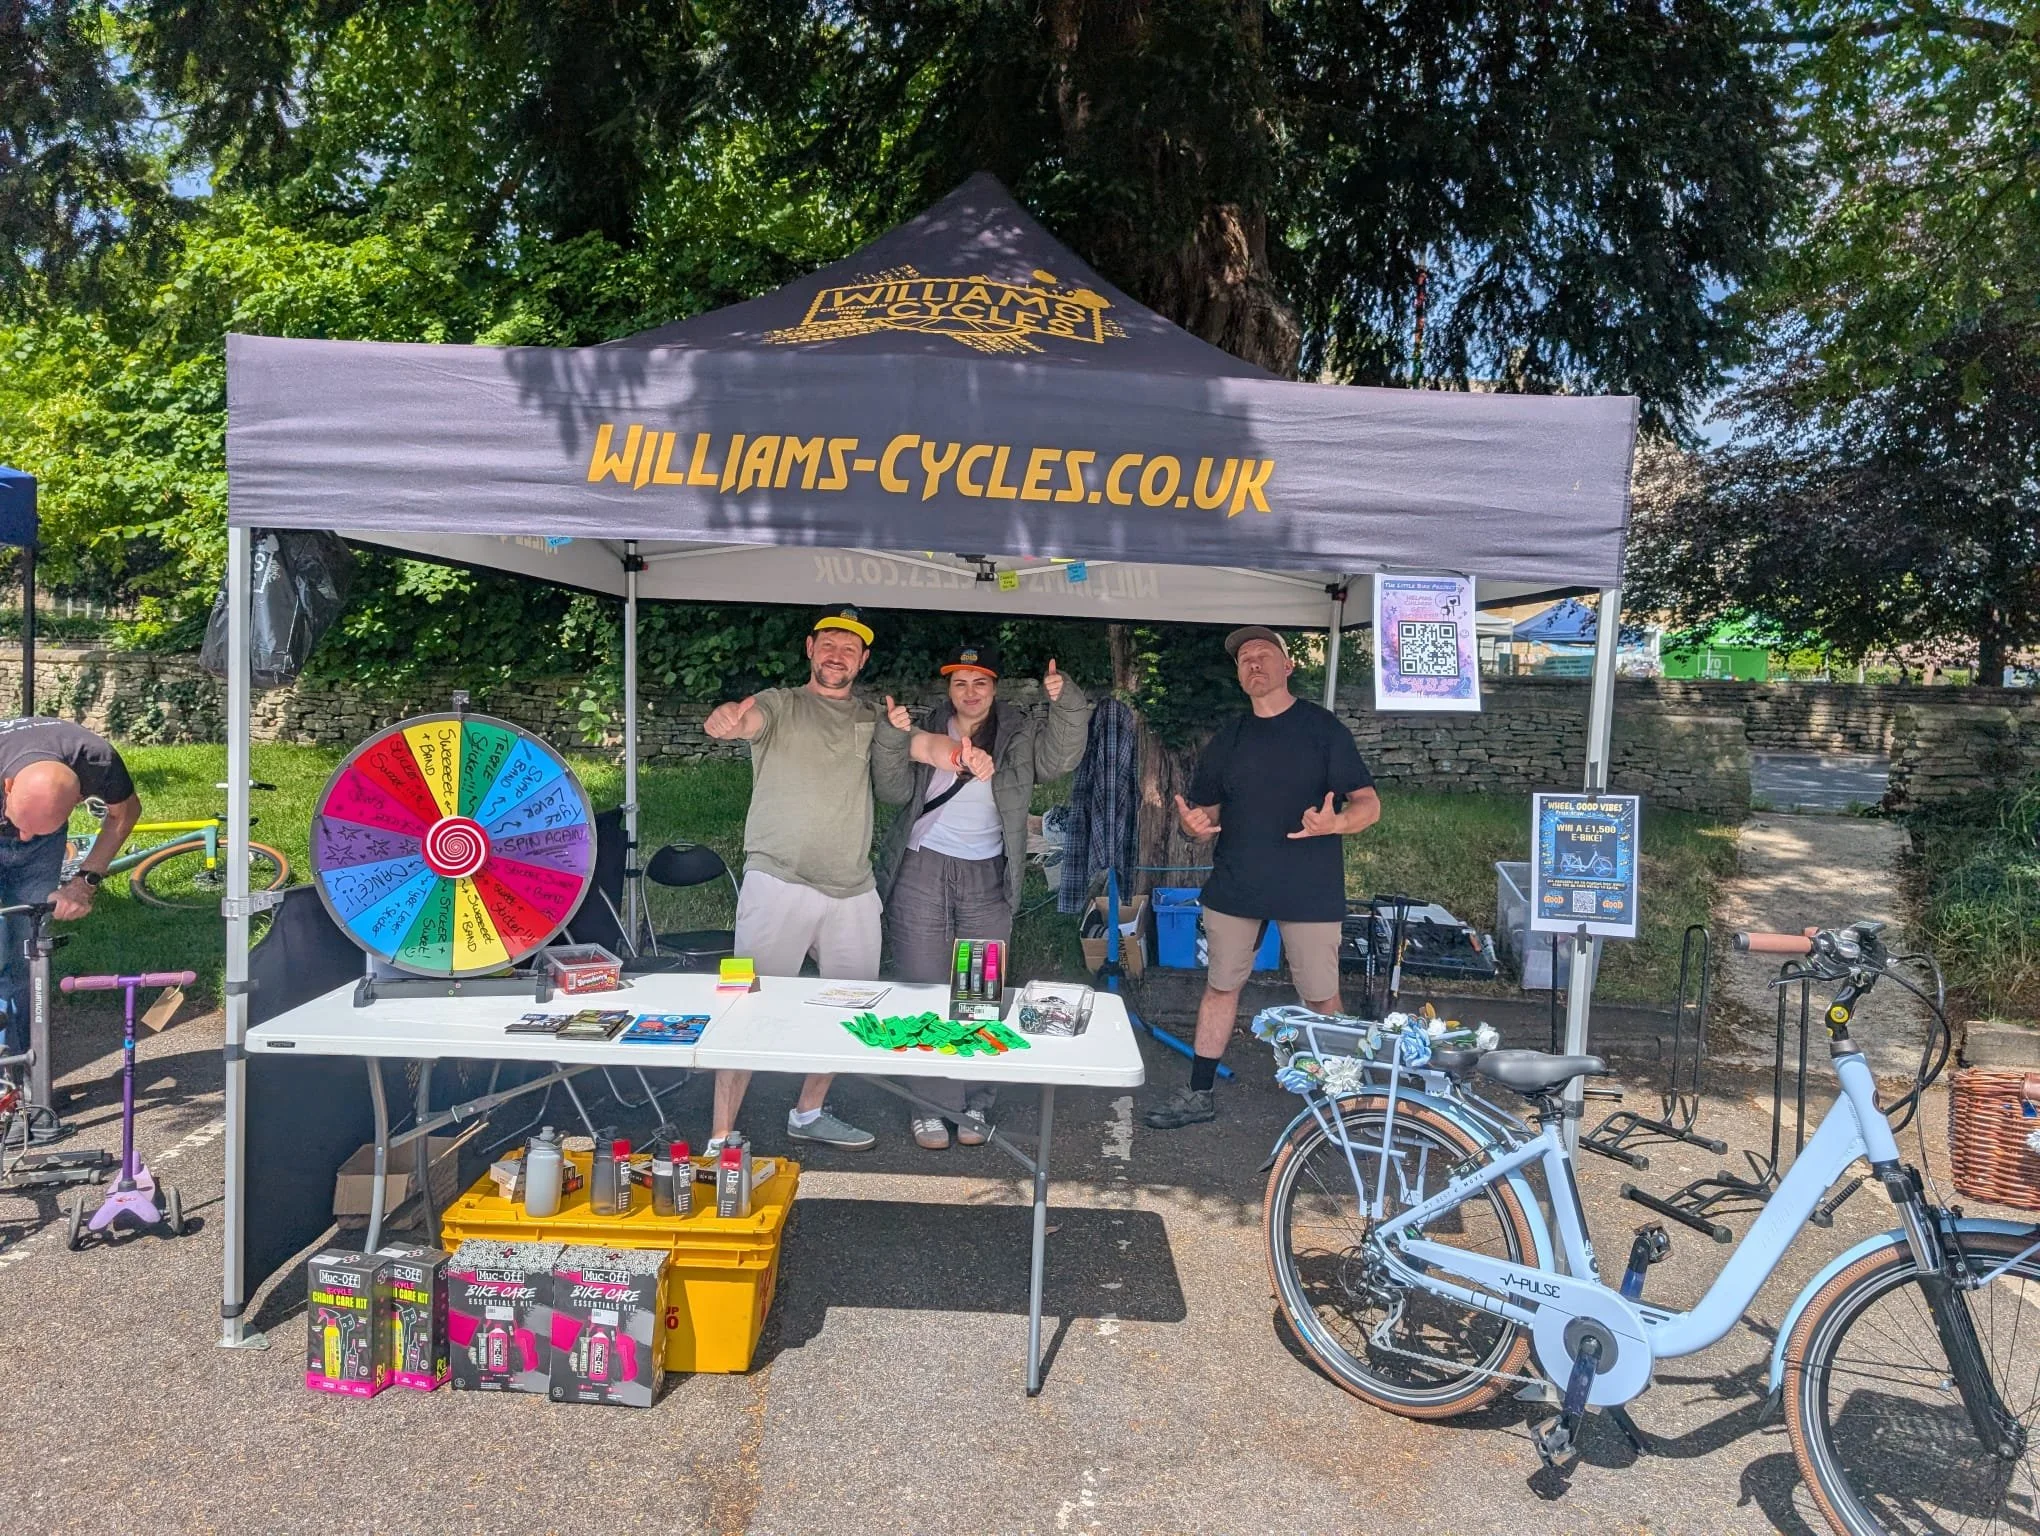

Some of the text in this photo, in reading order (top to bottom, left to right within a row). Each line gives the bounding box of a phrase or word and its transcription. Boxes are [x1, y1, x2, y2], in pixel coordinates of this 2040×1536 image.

[820, 303, 888, 313] CHELTENHAM
[833, 284, 1086, 323] WILLIAMS
[886, 302, 1076, 335] CYCLES
[587, 424, 1274, 518] WILLIAMS-CYCLES.CO.UK
[419, 744, 435, 776] BAND
[1548, 802, 1623, 812] WHEEL GOOD VIBES
[1557, 824, 1573, 832] WIN
[504, 828, 584, 852] SPIN AGAIN
[463, 920, 476, 952] BAND
[727, 1170, 739, 1183] FLY
[321, 1272, 359, 1287] Muc-Off
[394, 1268, 421, 1281] c-Off
[479, 1270, 522, 1282] Muc-Off
[585, 1270, 628, 1284] Muc-Off
[400, 1288, 416, 1301] CARE
[418, 1291, 428, 1304] KIT
[465, 1284, 537, 1299] BIKE CARE
[570, 1285, 641, 1302] BIKE CARE
[312, 1291, 368, 1310] CHAIN CARE KIT
[469, 1298, 516, 1307] ESSENTIALS
[574, 1300, 637, 1312] ESSENTIALS KIT
